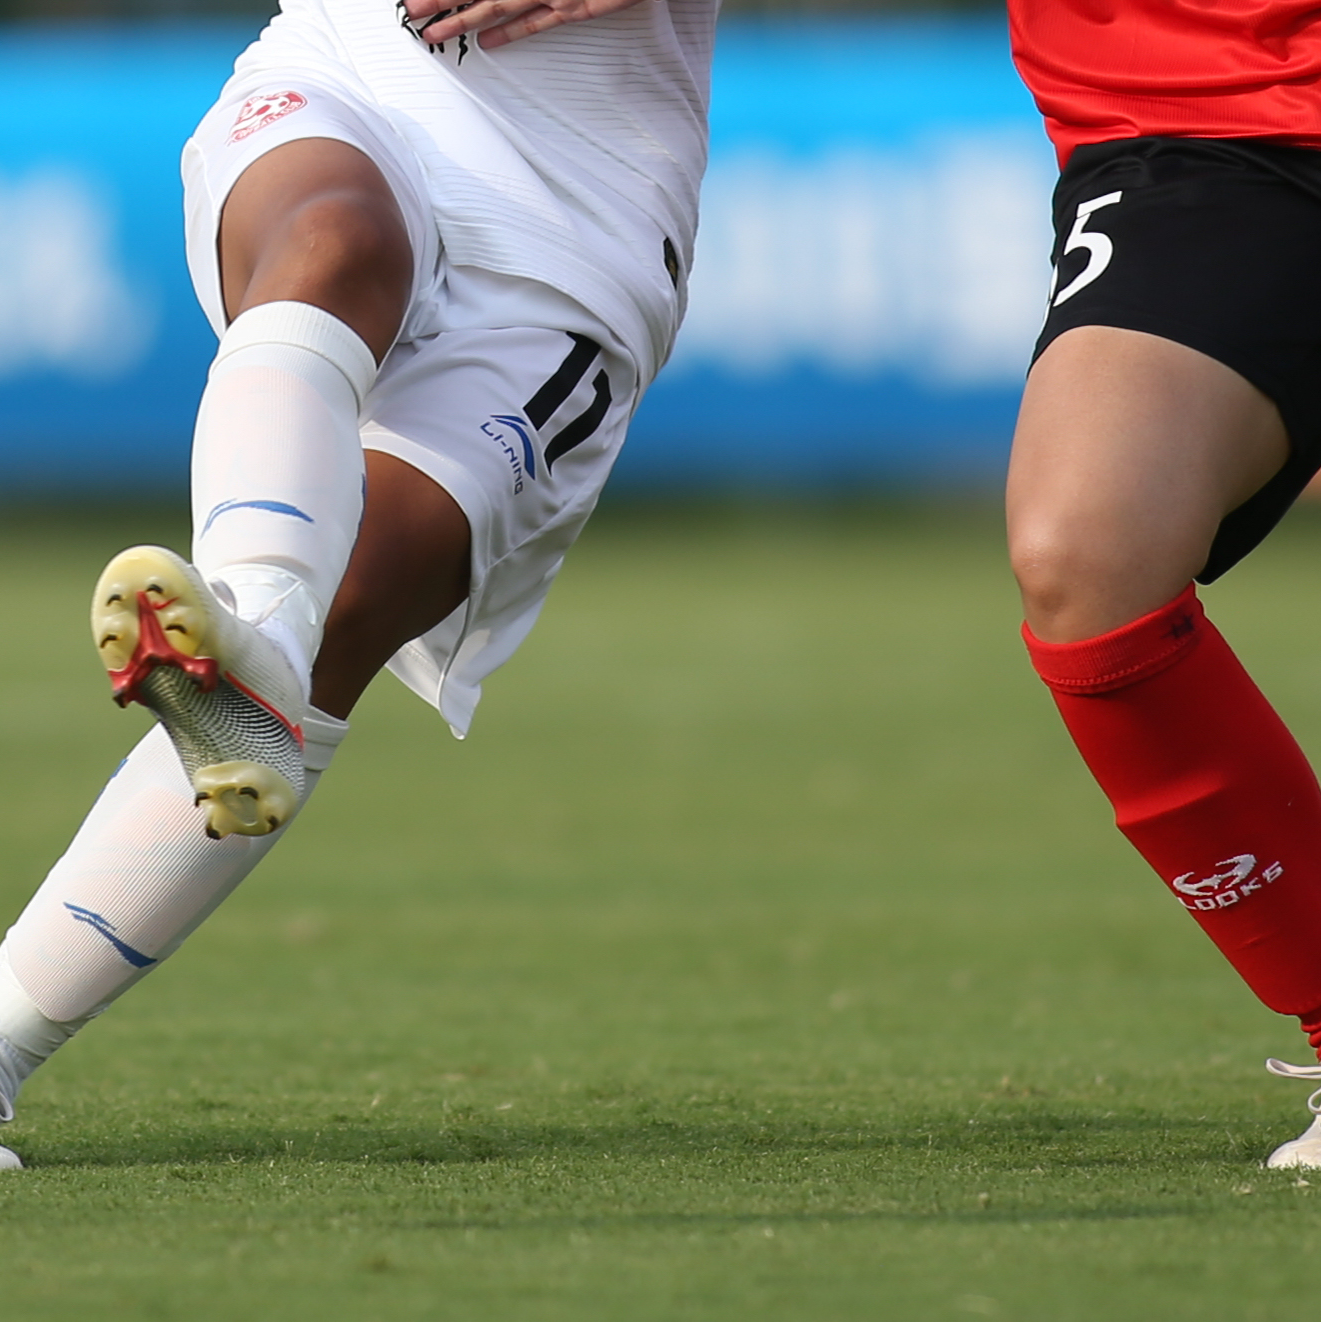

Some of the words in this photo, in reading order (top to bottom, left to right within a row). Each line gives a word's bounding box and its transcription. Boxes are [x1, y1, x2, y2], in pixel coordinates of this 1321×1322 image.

[1043, 190, 1123, 321] 5
[480, 421, 524, 496] LI-NING
[1177, 860, 1284, 911] LOOKS
